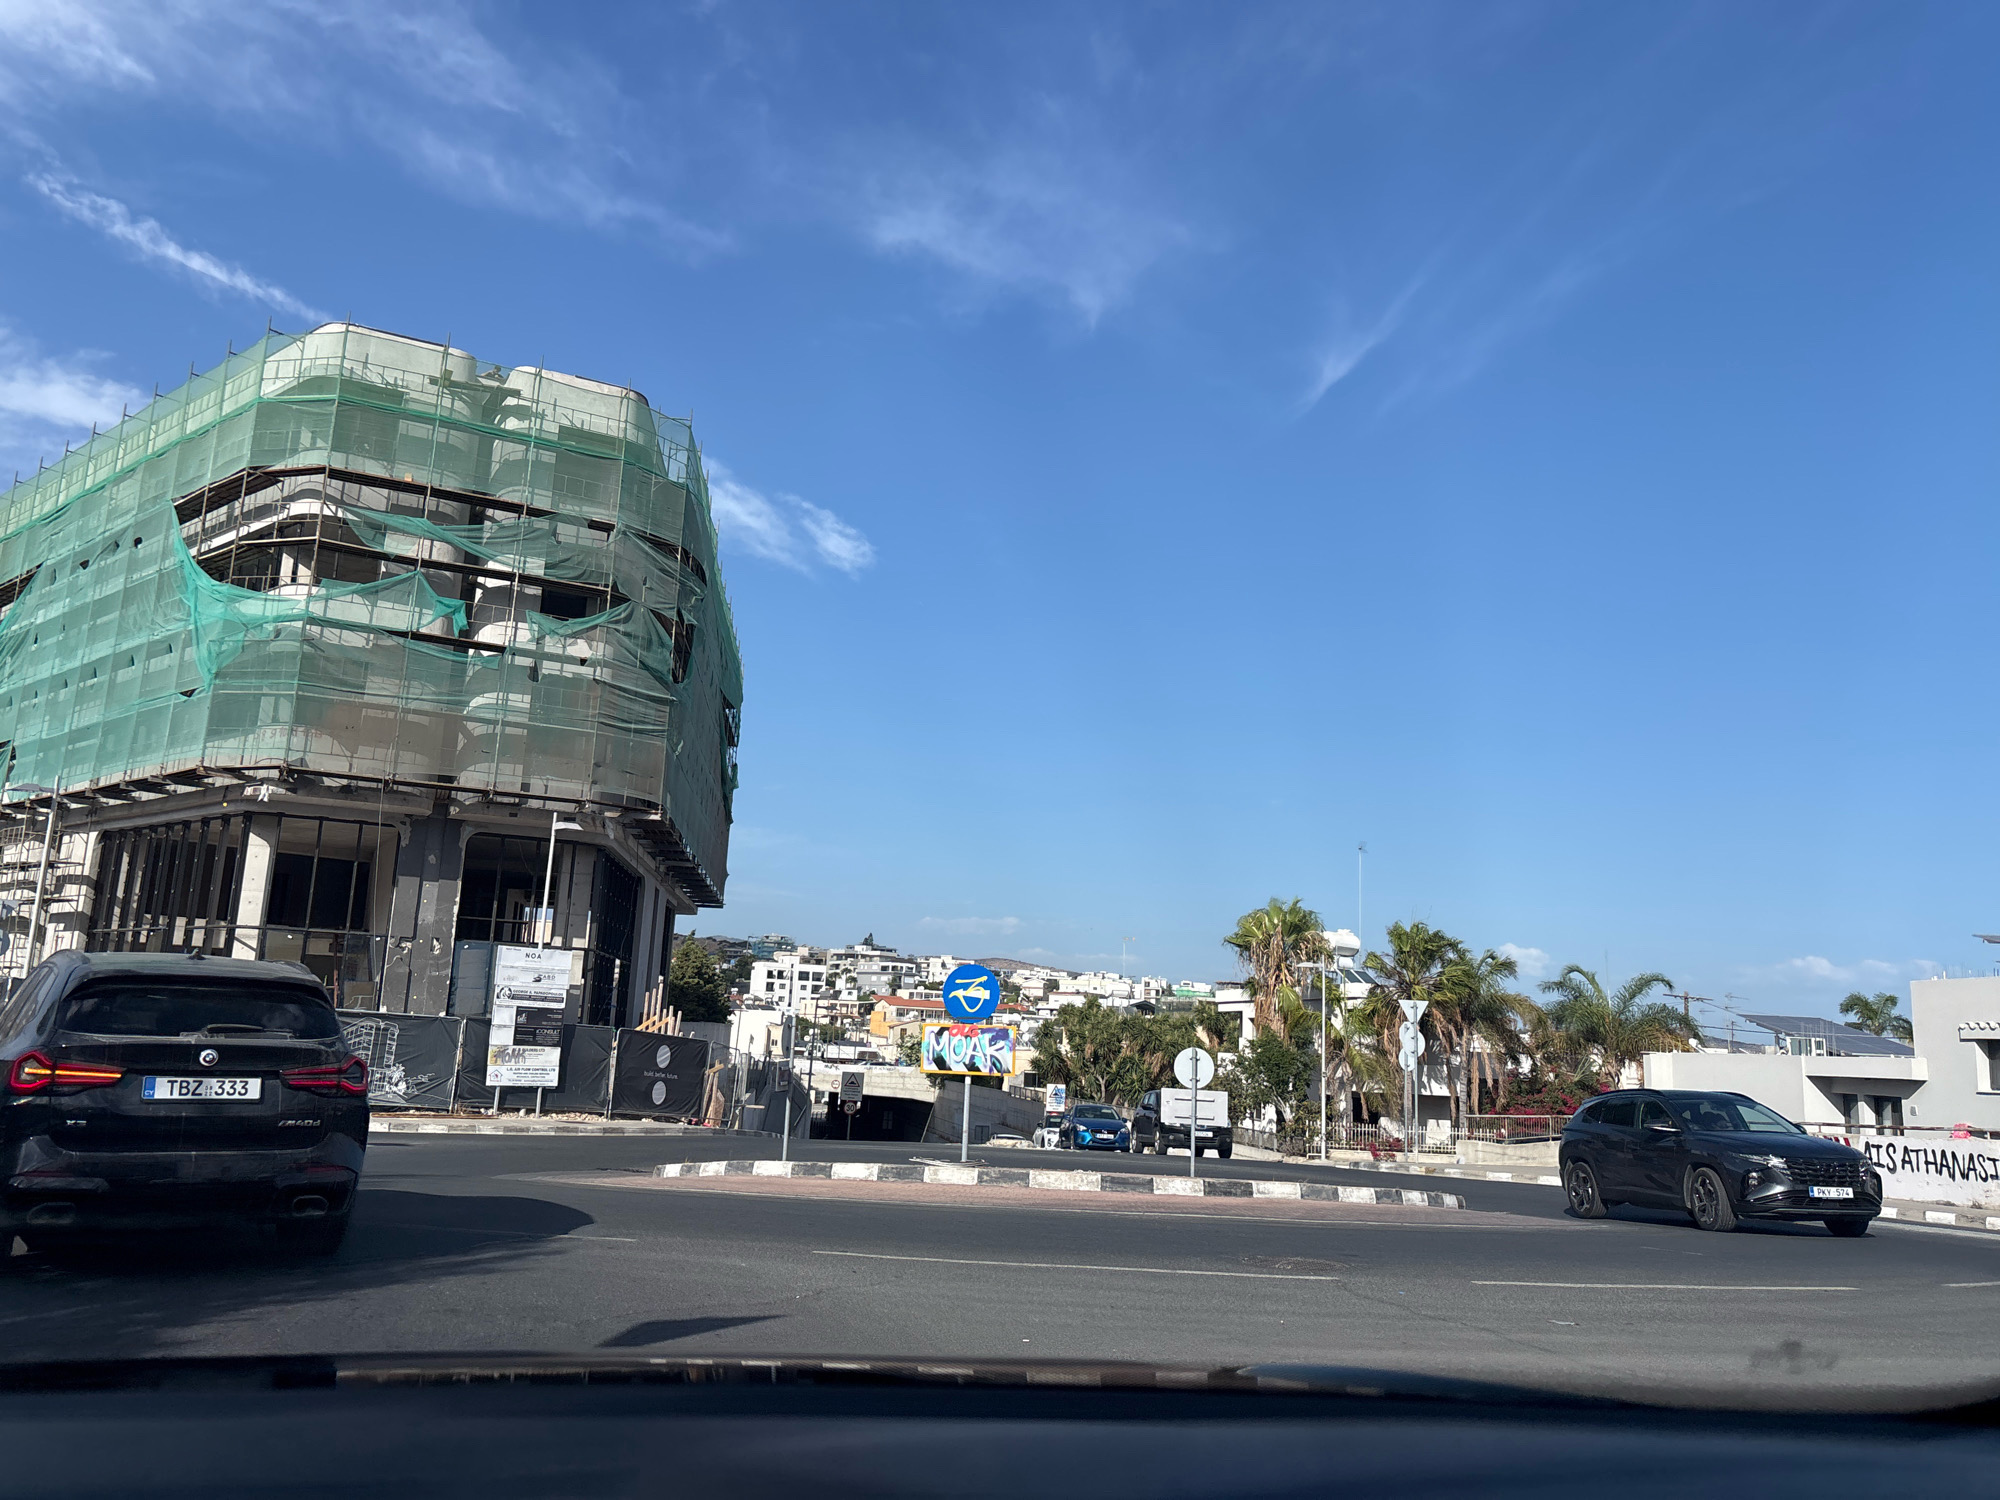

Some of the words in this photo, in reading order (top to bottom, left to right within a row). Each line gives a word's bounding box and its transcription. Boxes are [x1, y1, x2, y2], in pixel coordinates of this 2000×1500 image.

[525, 952, 542, 960] NOA
[928, 1030, 1006, 1067] MOAK
[167, 1080, 204, 1097] TBZ
[214, 1080, 249, 1097] 333
[846, 1104, 854, 1112] 30
[1864, 1141, 1897, 1174] AIS
[1901, 1145, 2000, 1182] ATHANASI
[1817, 1187, 1831, 1196] PKY
[1836, 1188, 1850, 1197] 574
